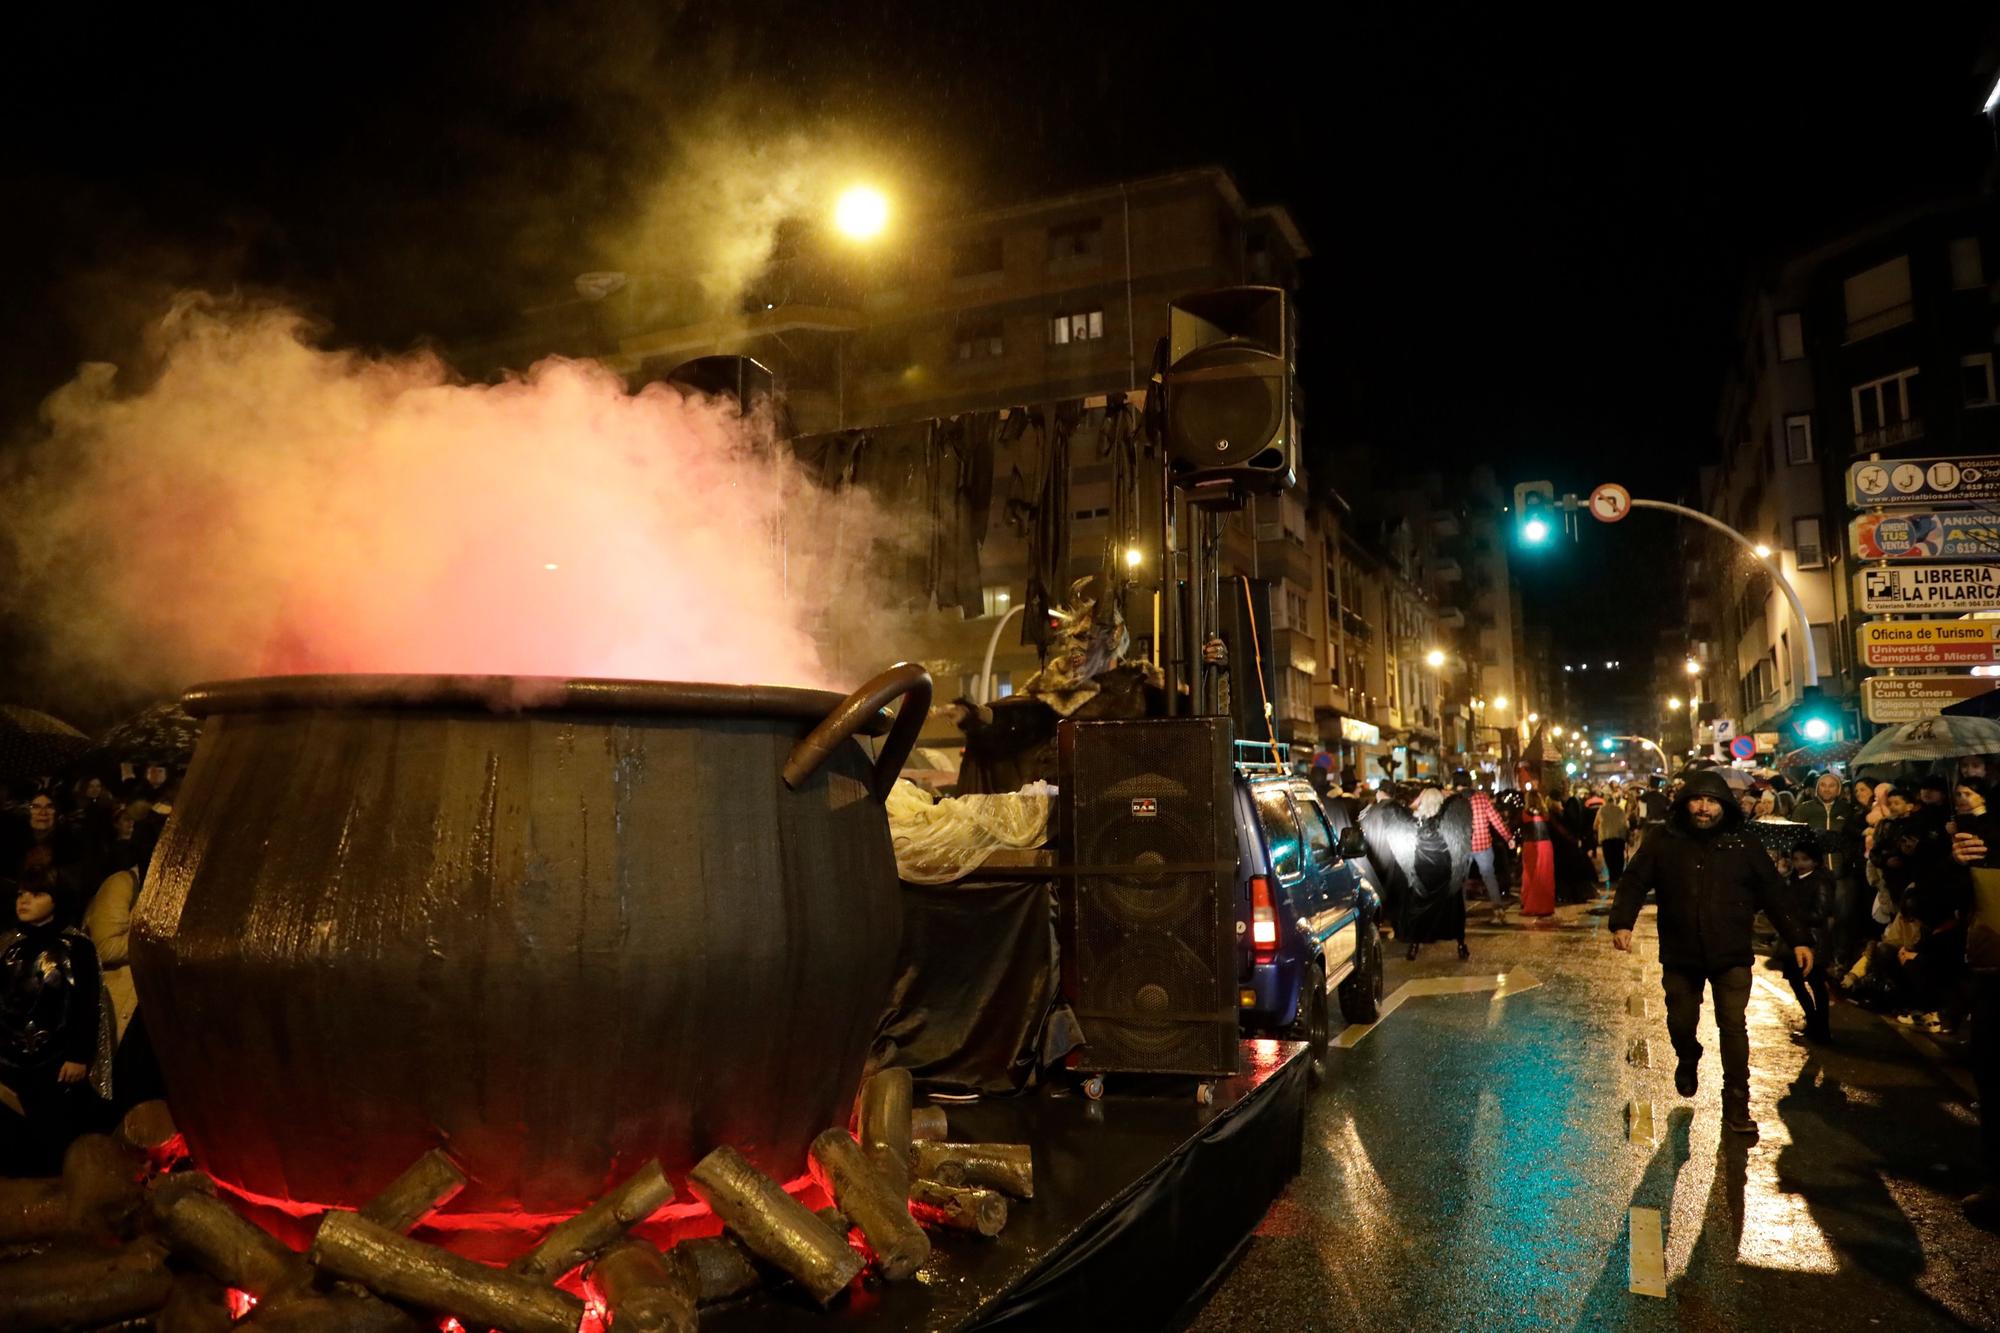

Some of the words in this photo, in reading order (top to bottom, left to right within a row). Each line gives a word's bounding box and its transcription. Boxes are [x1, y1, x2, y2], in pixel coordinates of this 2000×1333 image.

[1881, 531, 1909, 541] TUS
[1881, 541, 1910, 551] VENTAS
[1956, 542, 1977, 554] 619
[1914, 568, 1992, 583] LIBRERIA
[1902, 587, 1923, 601] LA
[1871, 628, 1912, 640] Oficina
[1917, 628, 1931, 638] de
[1936, 627, 1984, 638] Turismo
[1871, 653, 1921, 663] Campus
[1924, 652, 1940, 661] de
[1944, 651, 1987, 661] Mieres
[1874, 680, 1904, 689] Valle
[1907, 680, 1923, 689] de
[1874, 689, 1906, 698] Cuna
[1909, 688, 1953, 697] Cenera
